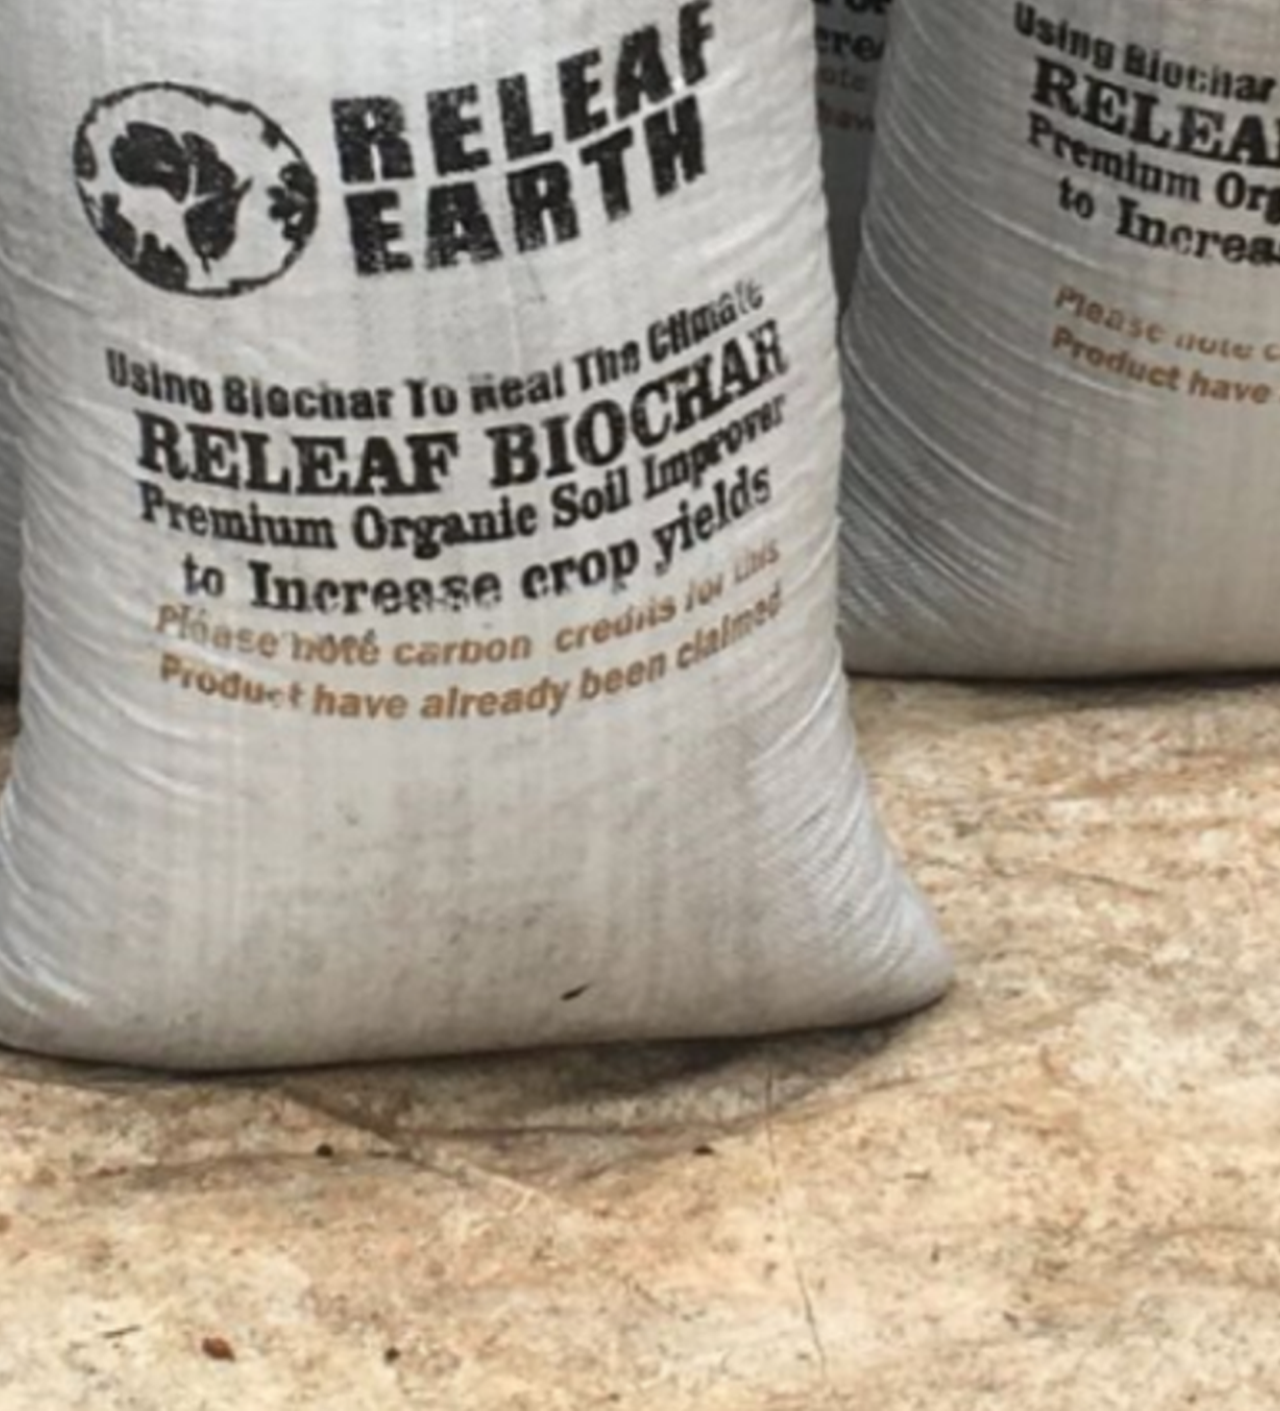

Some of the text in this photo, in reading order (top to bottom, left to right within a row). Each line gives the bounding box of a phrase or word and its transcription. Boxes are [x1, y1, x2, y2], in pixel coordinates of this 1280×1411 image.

[1015, 1, 1115, 72] Using
[1123, 42, 1278, 105] Biochar
[344, 94, 706, 276] EARTH
[1028, 110, 1201, 203] Premium
[1058, 176, 1095, 220] to
[1055, 286, 1164, 344] Please
[106, 347, 213, 413] Using
[223, 375, 394, 420] Biochar
[405, 378, 459, 419] To
[574, 340, 641, 390] The
[134, 318, 788, 497] RELEAF BIOCHAR
[1052, 326, 1181, 391] Product
[1189, 372, 1273, 405] have
[138, 393, 786, 560] Premium Organic Soil Improver
[182, 465, 772, 615] to Increase crop yields
[159, 582, 784, 721] Product have already been claimed
[392, 637, 533, 667] carbon
